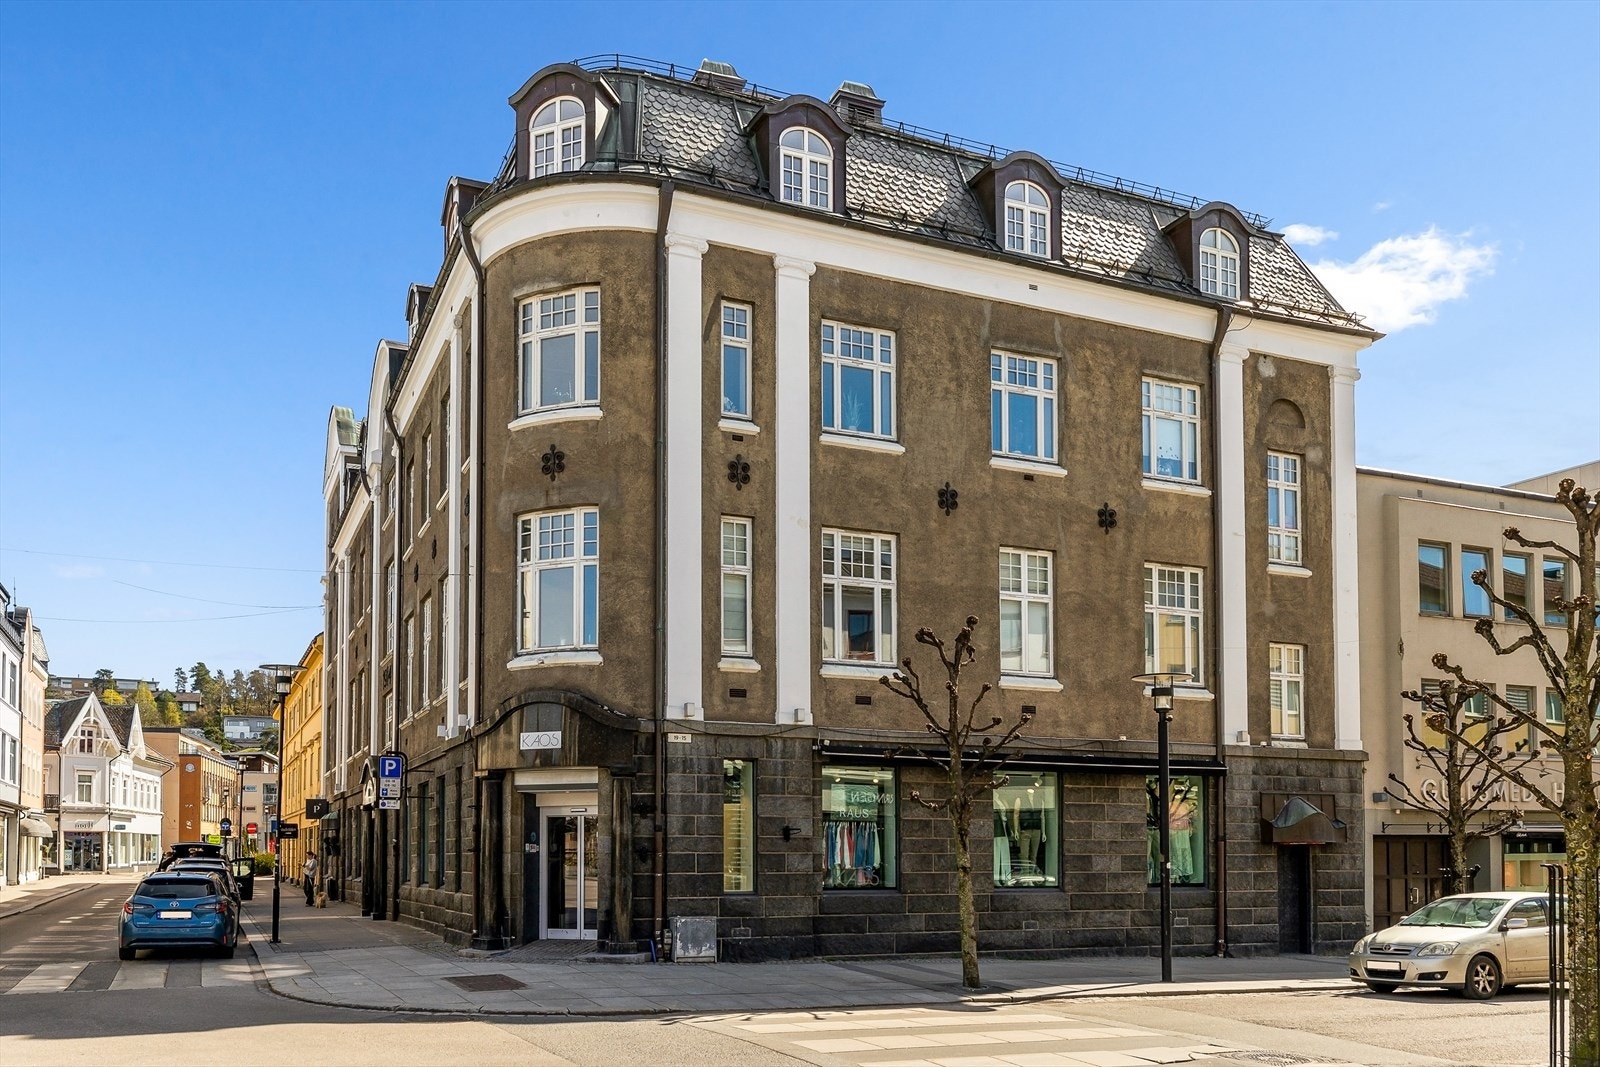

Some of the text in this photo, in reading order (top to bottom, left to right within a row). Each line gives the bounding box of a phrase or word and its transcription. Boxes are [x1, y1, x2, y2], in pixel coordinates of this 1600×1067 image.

[521, 733, 560, 748] KAOS
[385, 759, 397, 776] P
[1421, 779, 1533, 802] GULSMED
[839, 807, 869, 818] RAUS
